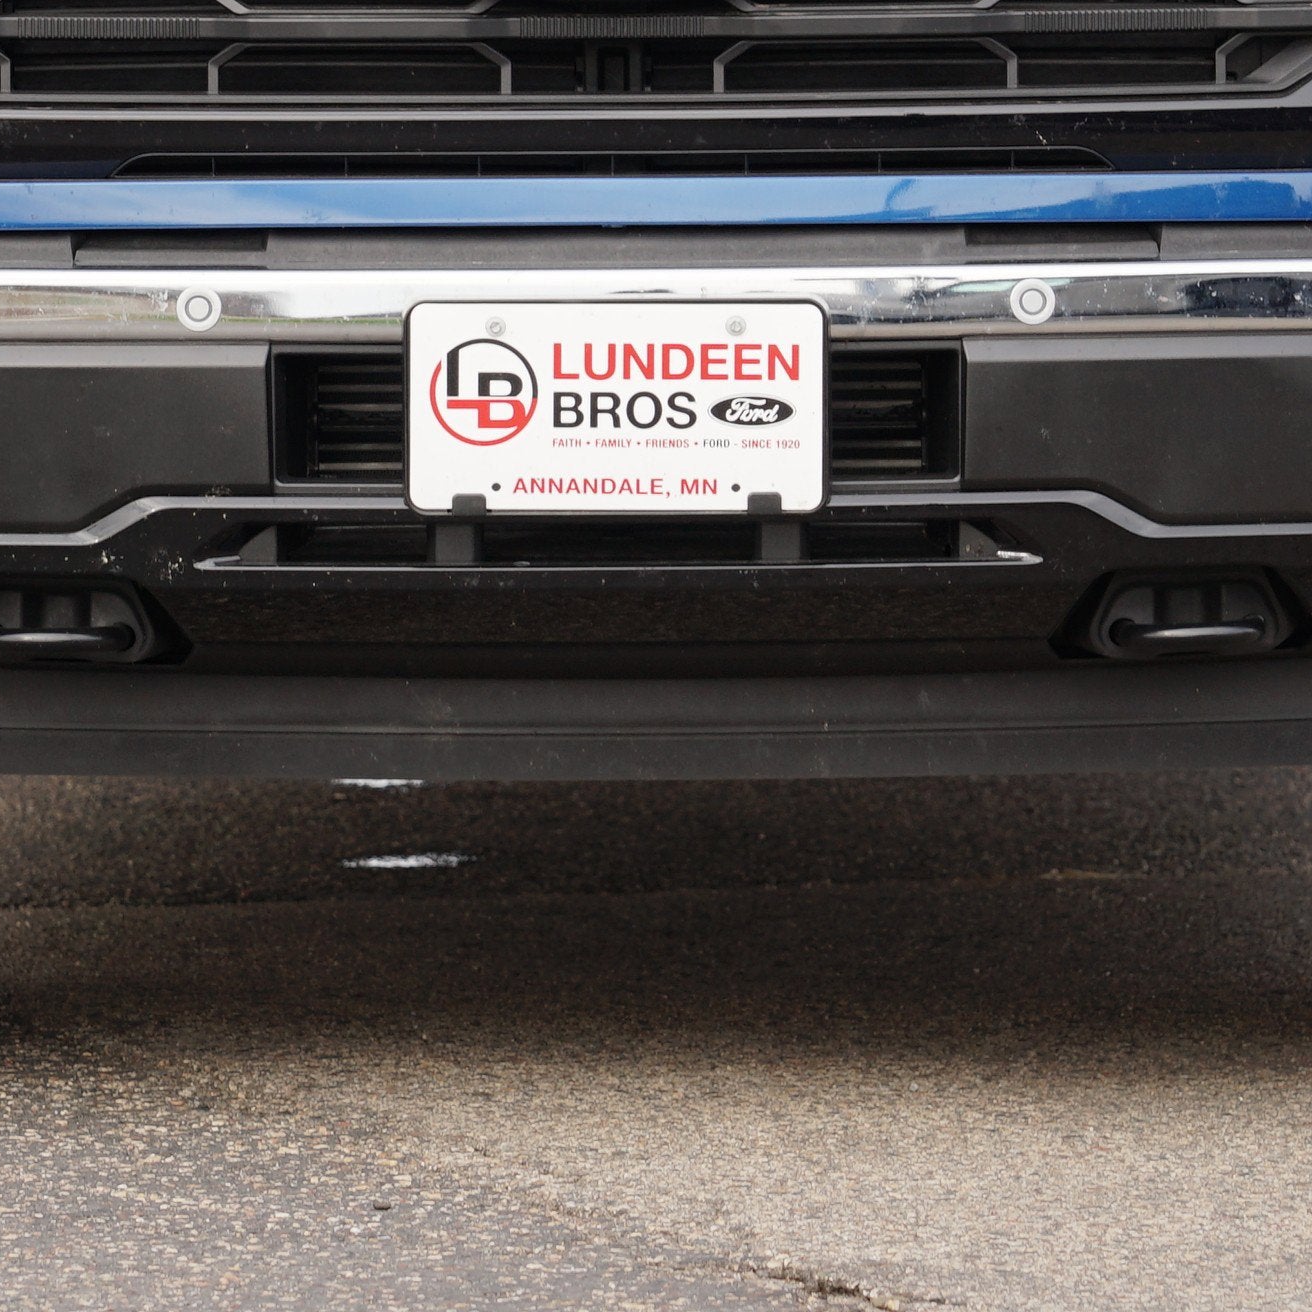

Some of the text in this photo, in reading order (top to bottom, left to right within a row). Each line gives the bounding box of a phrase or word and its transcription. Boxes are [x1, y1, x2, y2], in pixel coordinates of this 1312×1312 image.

[552, 343, 800, 381] LUNDEEN
[552, 391, 698, 429] BROS
[725, 397, 780, 423] Ford
[552, 438, 801, 449] FAITH FAMILY FRIENDS FORD SINCE 1920
[513, 478, 719, 498] ANNANDALE, MN
